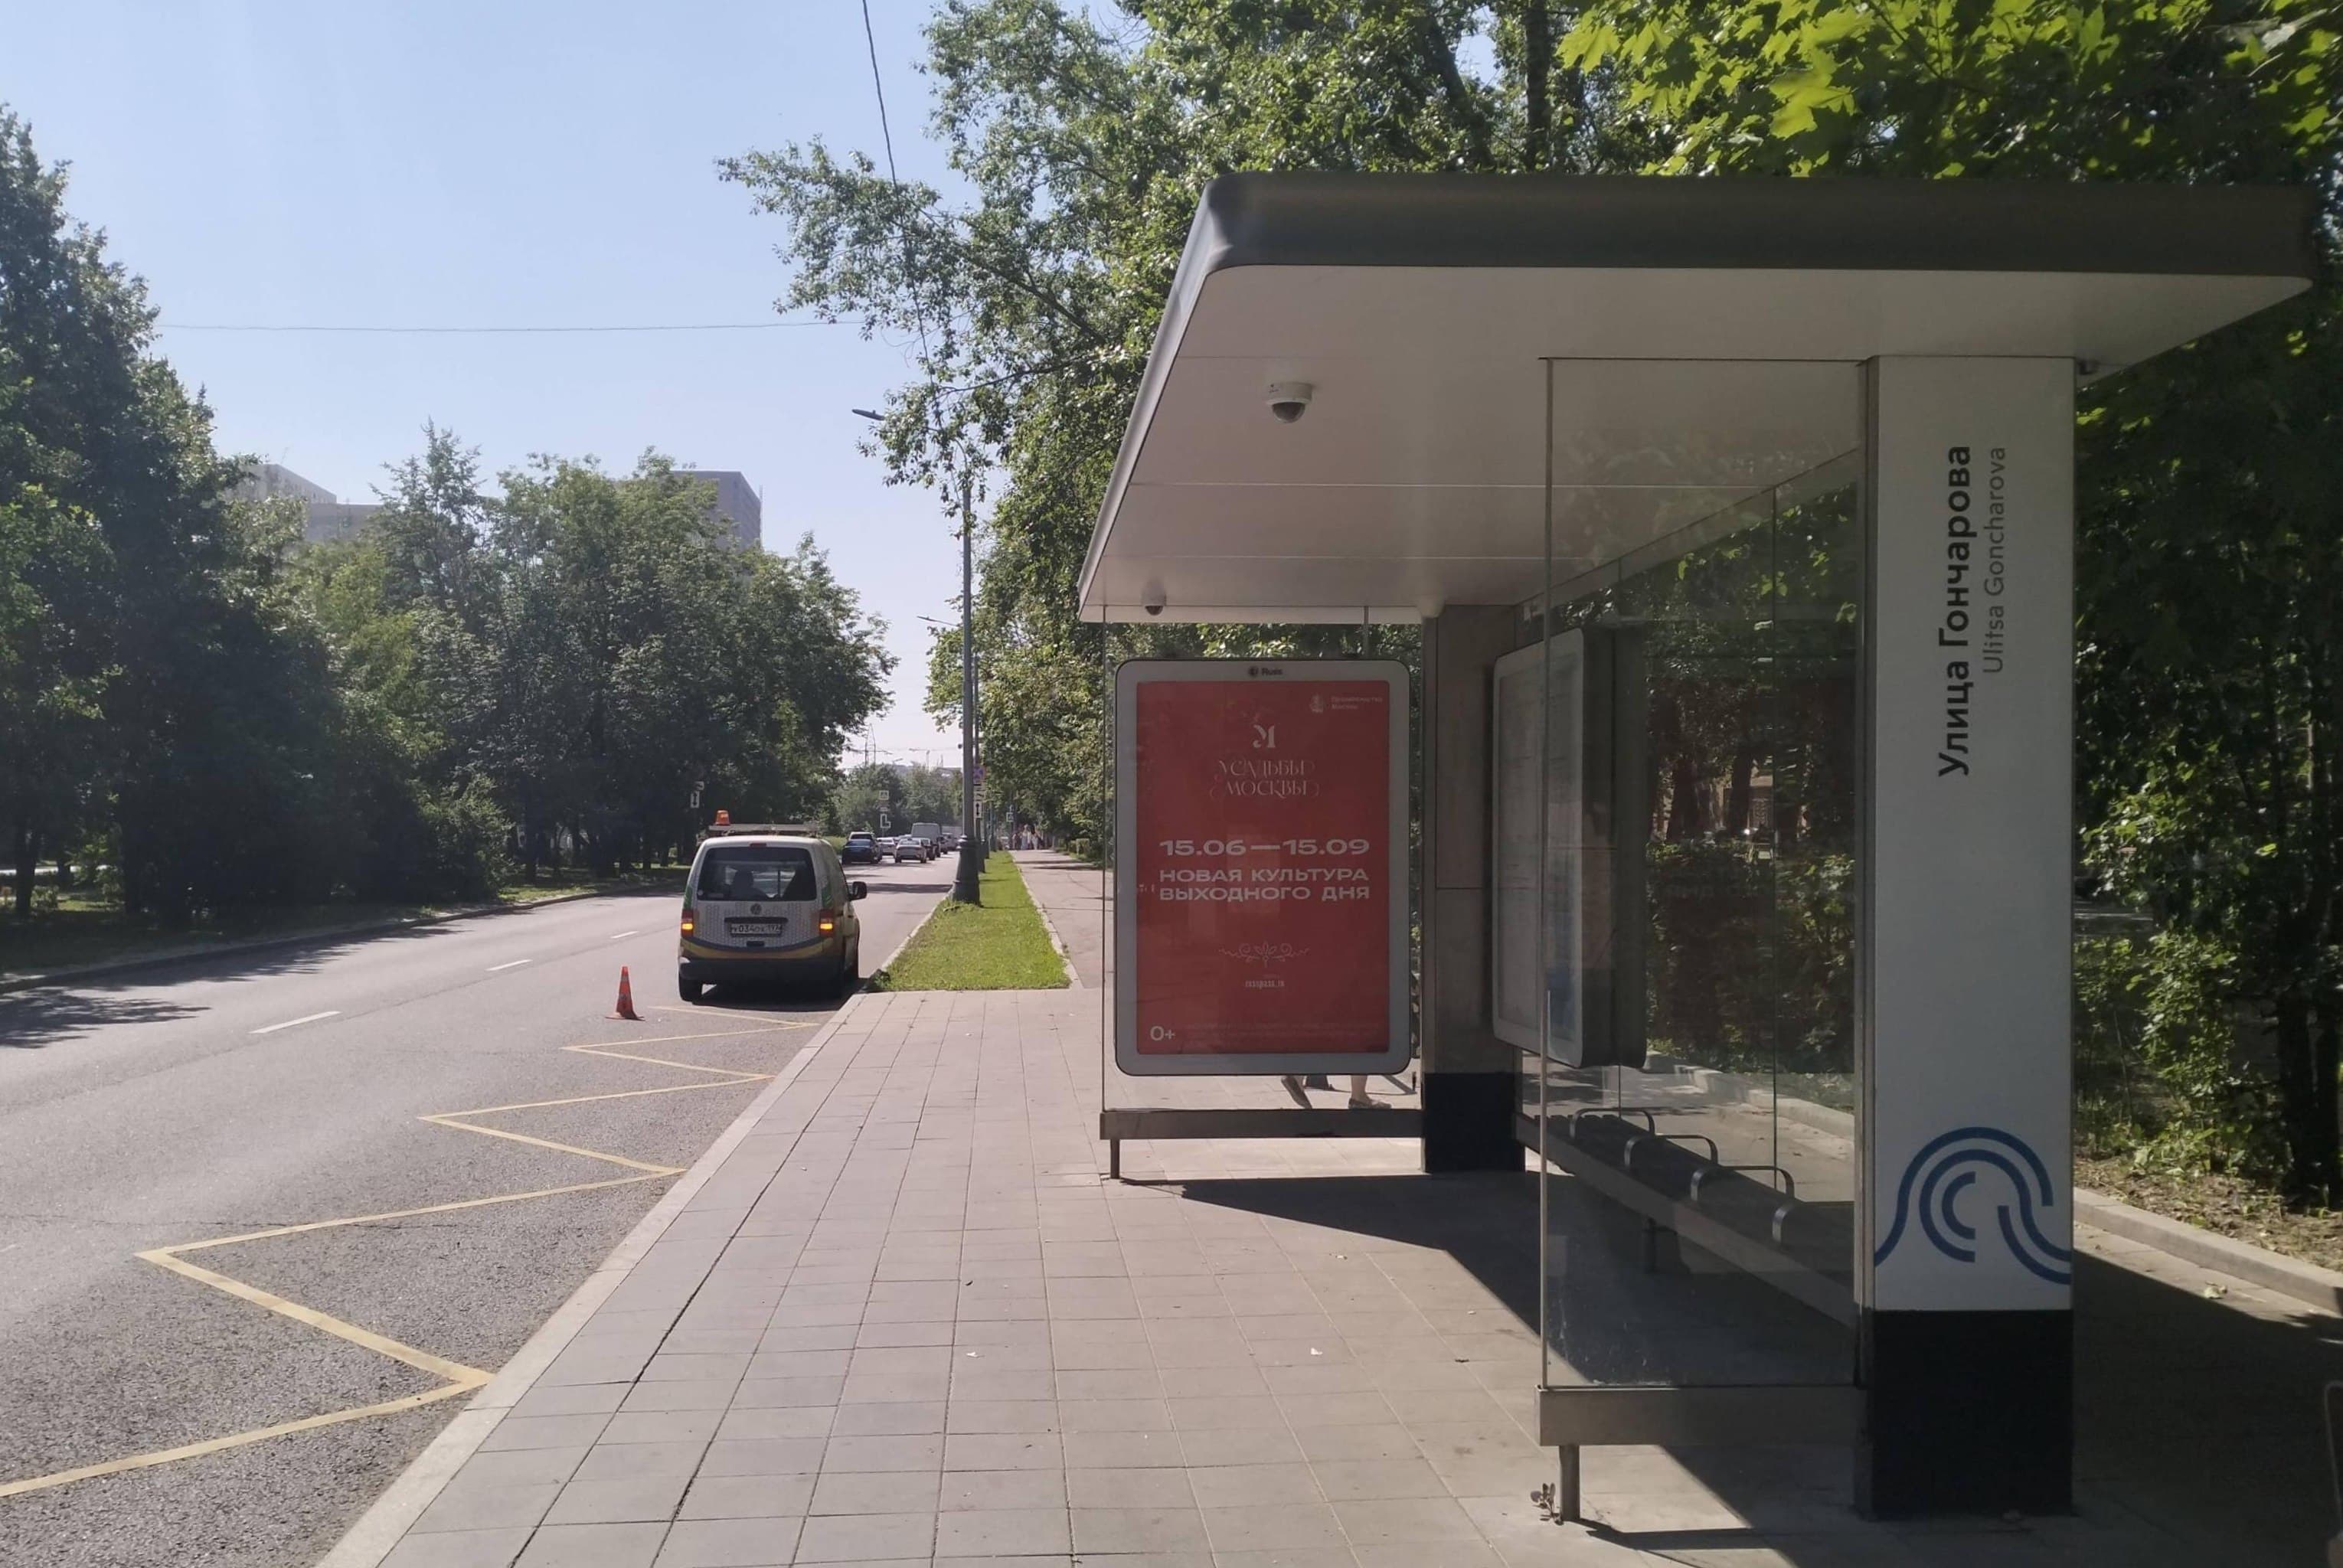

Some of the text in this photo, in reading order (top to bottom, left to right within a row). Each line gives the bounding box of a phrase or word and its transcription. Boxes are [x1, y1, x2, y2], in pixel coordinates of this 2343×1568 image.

[1938, 446, 1978, 776] Улица Гончарова
[1982, 447, 2006, 673] Ulitsa Goncharova
[1159, 867, 1370, 883] НОВАЯ КУЛЬТУРА
[1159, 886, 1370, 902] ВЫХОДНОГО ДНЯ
